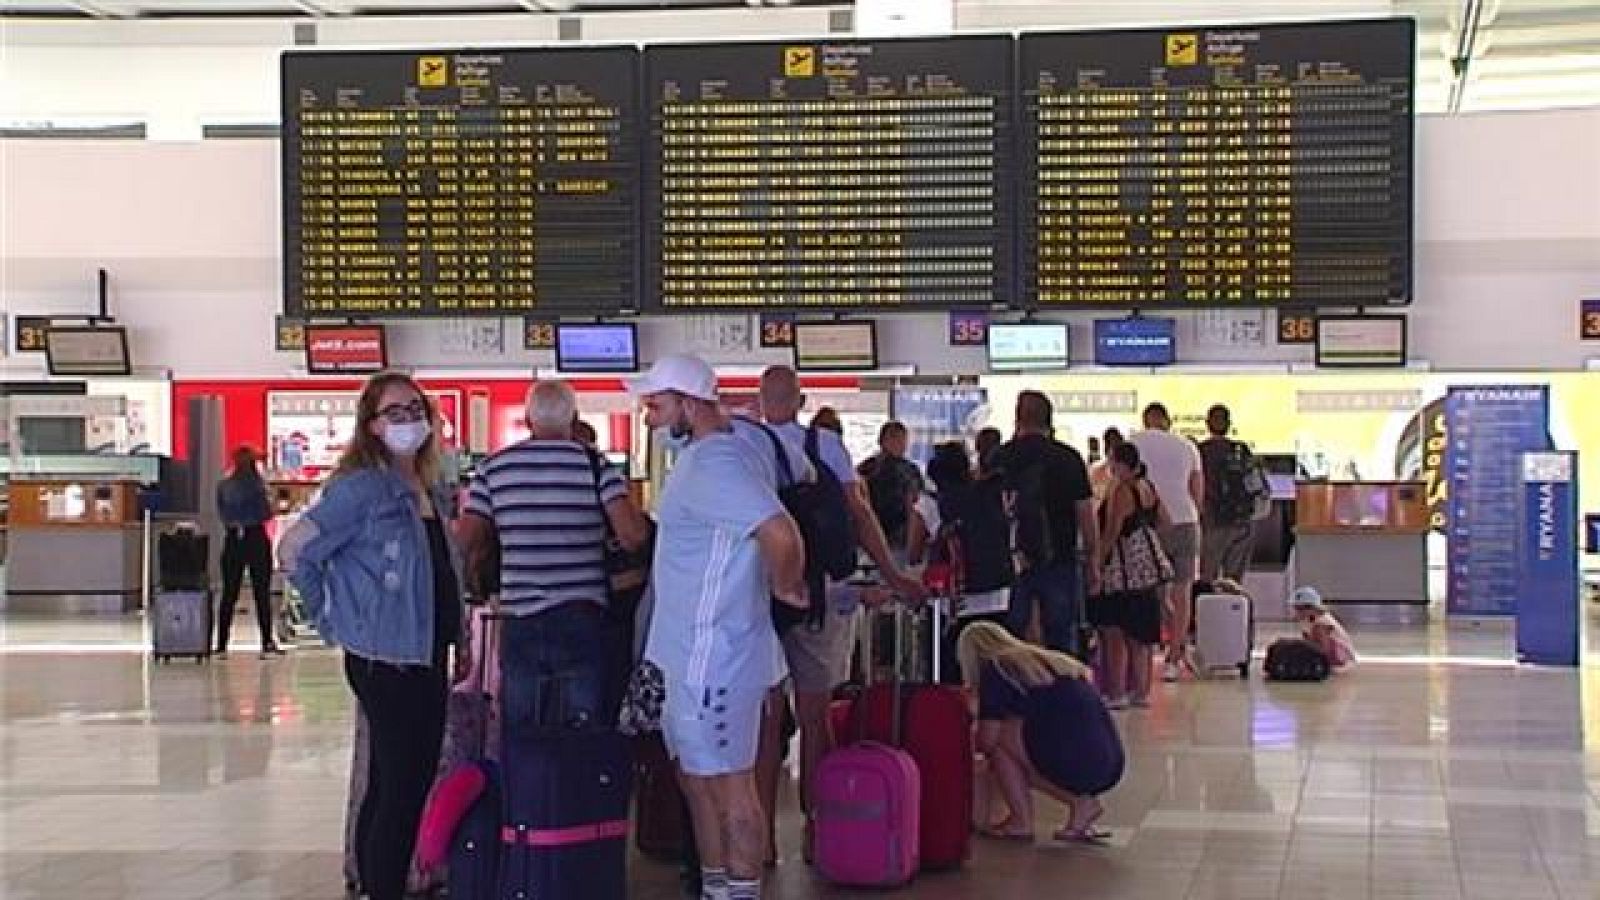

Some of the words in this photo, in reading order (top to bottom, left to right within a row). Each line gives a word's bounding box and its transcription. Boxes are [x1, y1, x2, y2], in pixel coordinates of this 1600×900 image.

[764, 321, 791, 344] 34
[954, 319, 984, 341] 35
[1281, 317, 1313, 339] 36
